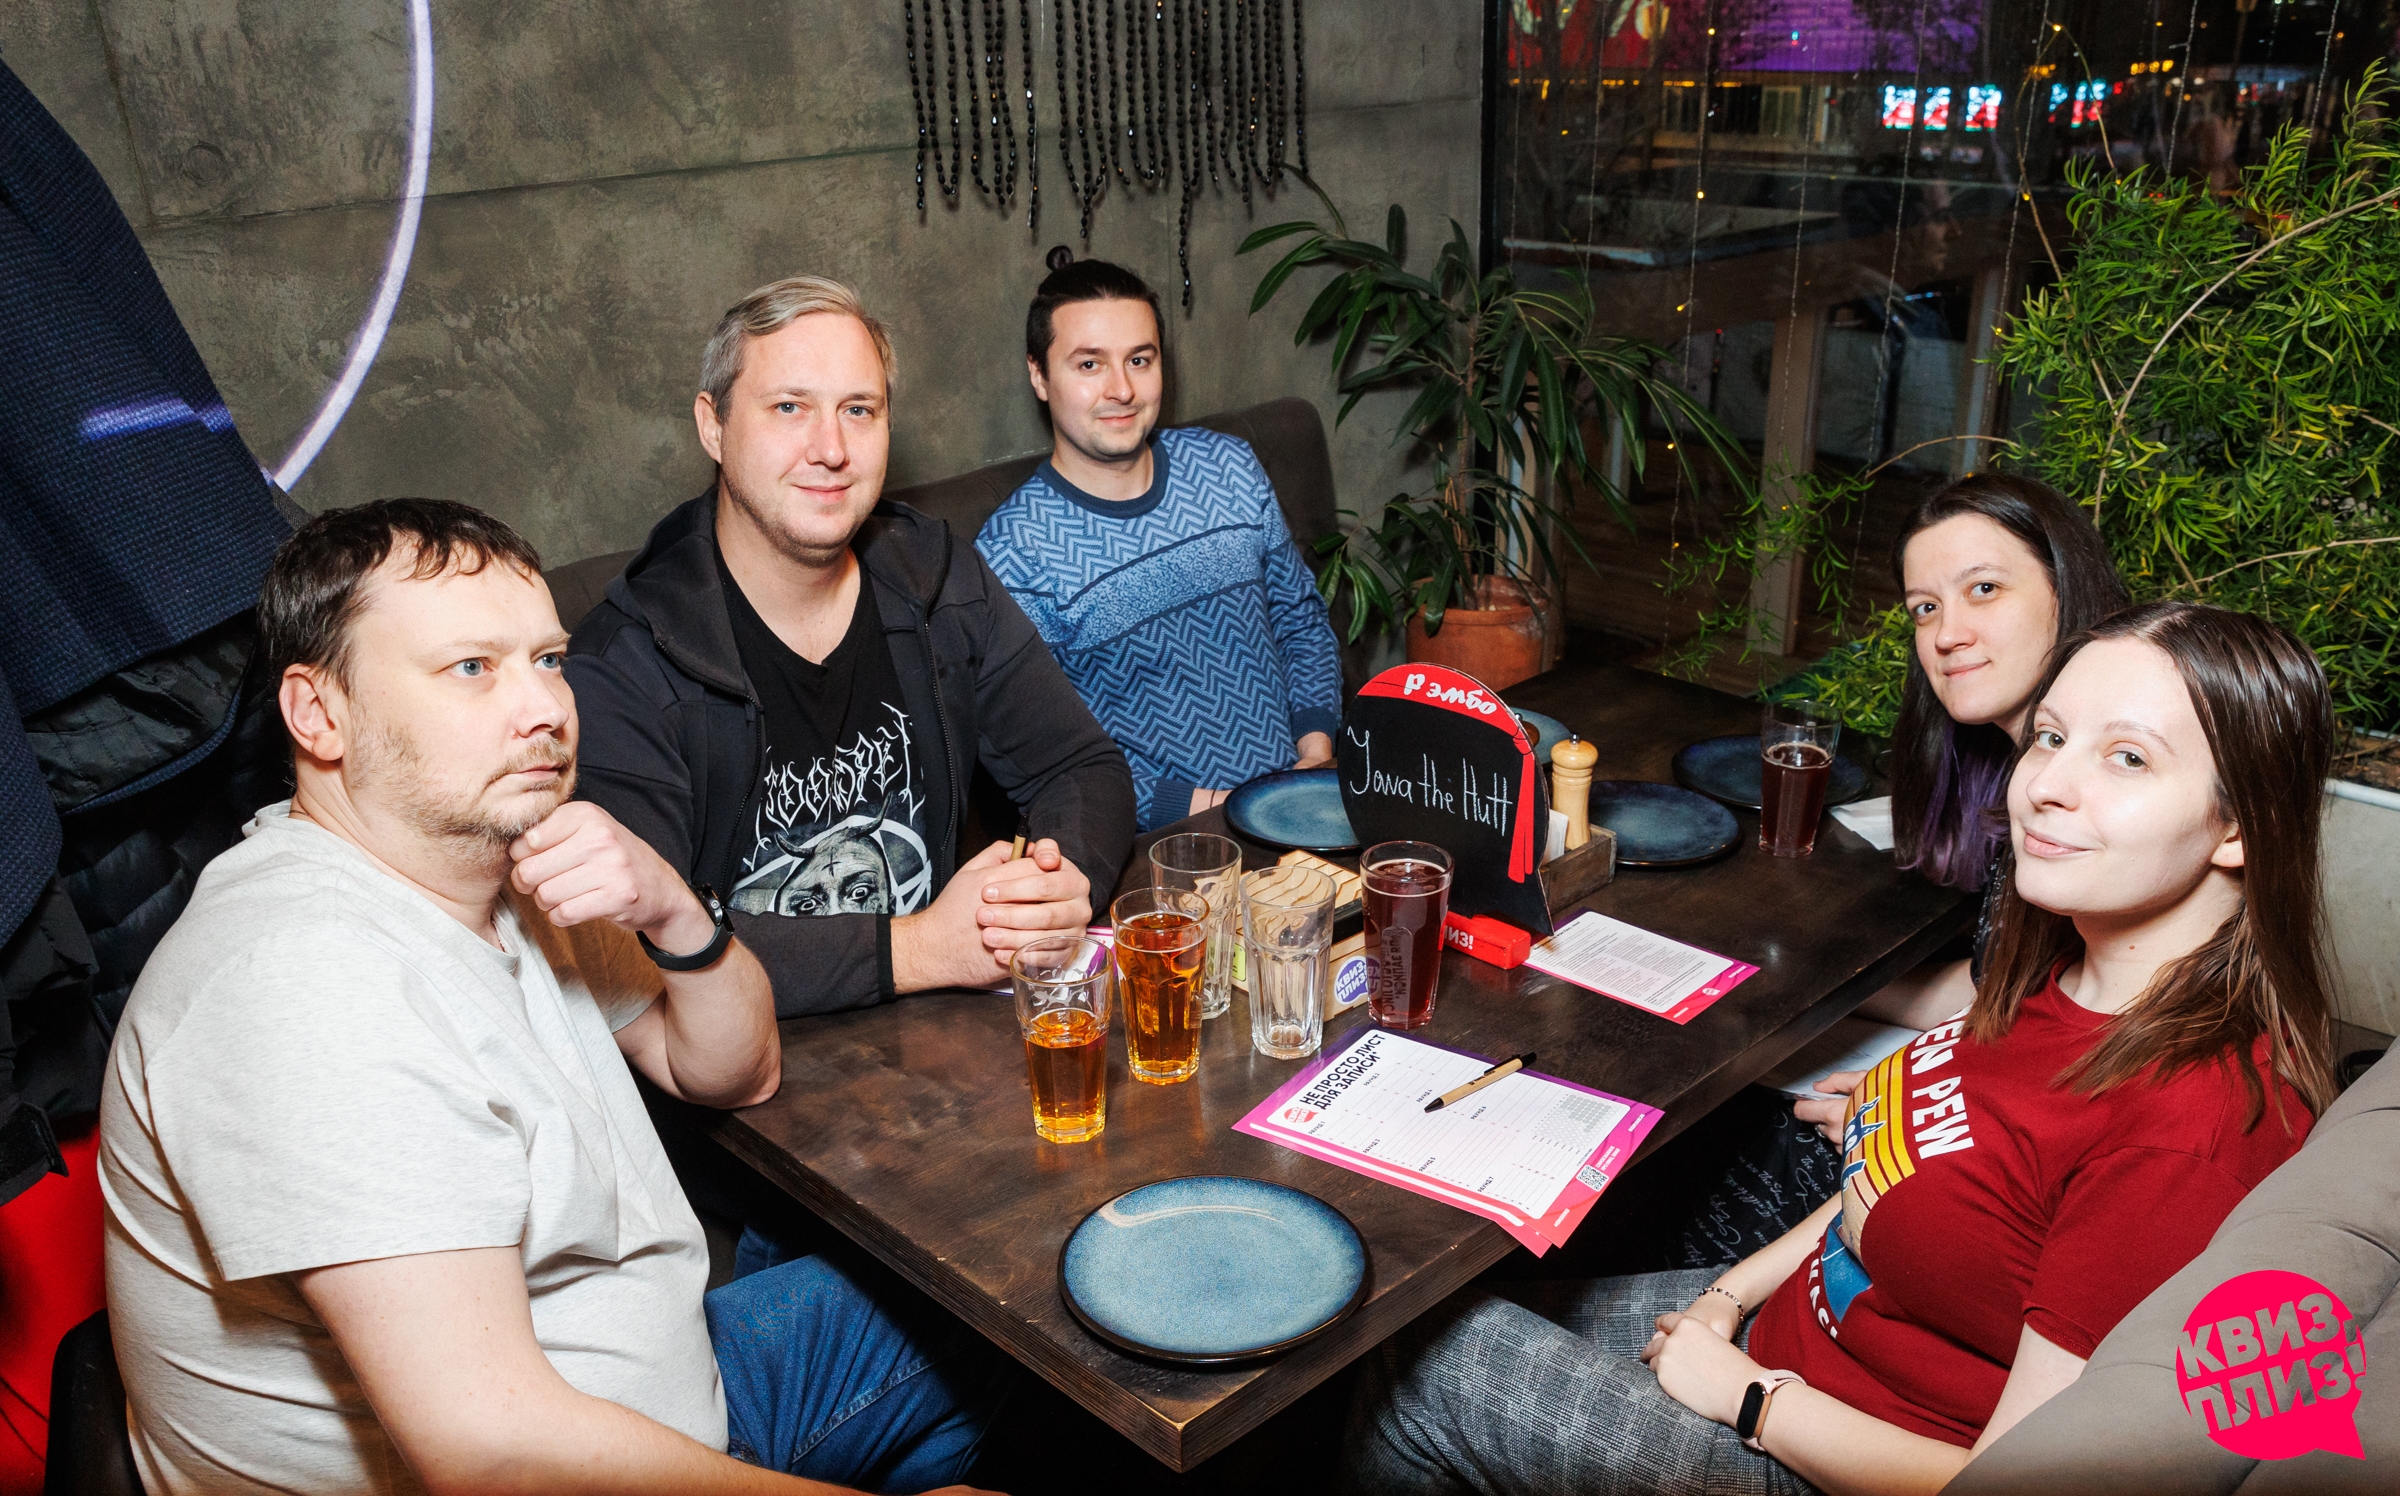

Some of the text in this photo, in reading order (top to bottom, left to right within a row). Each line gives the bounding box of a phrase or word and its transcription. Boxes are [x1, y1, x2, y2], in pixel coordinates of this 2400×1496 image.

[1417, 753, 1456, 815] the
[1462, 757, 1514, 837] Hutt
[1299, 1033, 1386, 1105] НЕ ПРОСТО ЛИСТ
[1313, 1090, 1342, 1110] ДЛЯ
[1911, 1076, 1975, 1160] PEW
